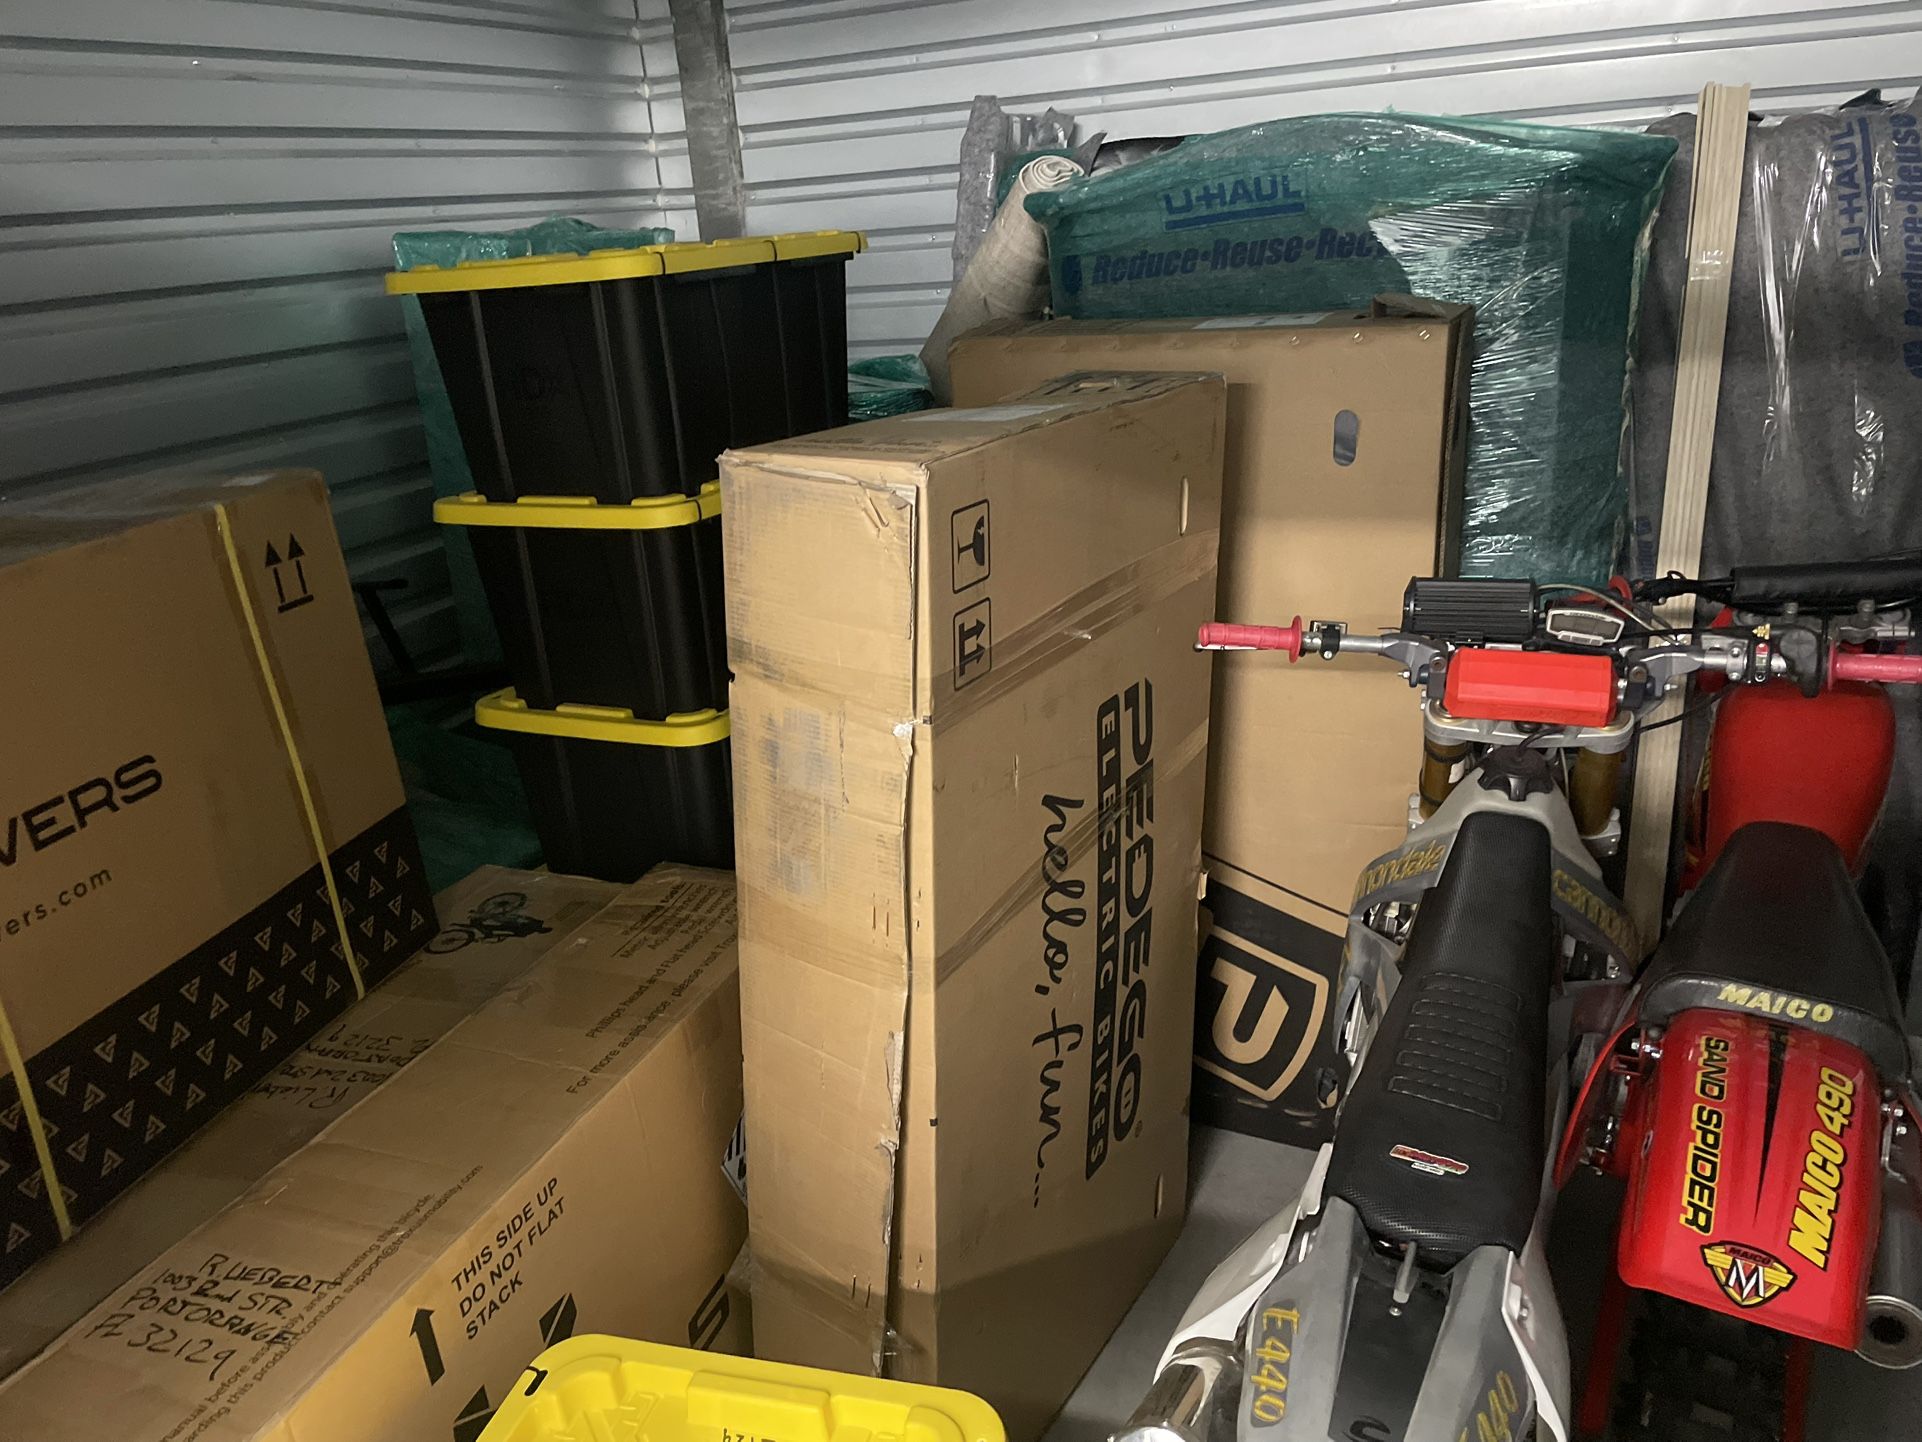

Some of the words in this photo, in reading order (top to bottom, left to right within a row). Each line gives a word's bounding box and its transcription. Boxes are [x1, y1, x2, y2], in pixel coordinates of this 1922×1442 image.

[1099, 709, 1117, 991] ELECTRIC
[0, 869, 113, 942] ers.com
[1115, 678, 1154, 1142] PEDEGO
[1717, 982, 1834, 1023] MAICO
[566, 1073, 592, 1094] For
[589, 1049, 620, 1075] more
[1090, 1022, 1112, 1165] BIKES
[1695, 1035, 1729, 1102] SAND
[1815, 1066, 1855, 1137] 490
[1679, 1103, 1725, 1236] SPIDER
[1788, 1130, 1847, 1272] MAICO
[451, 1245, 493, 1292] THIS
[496, 1202, 535, 1249] SIDE
[536, 1177, 559, 1207] UP
[459, 1283, 486, 1318] DO
[489, 1240, 523, 1286] NOT
[527, 1196, 565, 1246] FLAT
[1728, 1246, 1772, 1264] MAICO
[466, 1271, 523, 1340] STACK
[127, 1323, 237, 1382] 32129
[205, 1364, 250, 1403] before
[1251, 1305, 1299, 1423] E440
[227, 1383, 253, 1405] this
